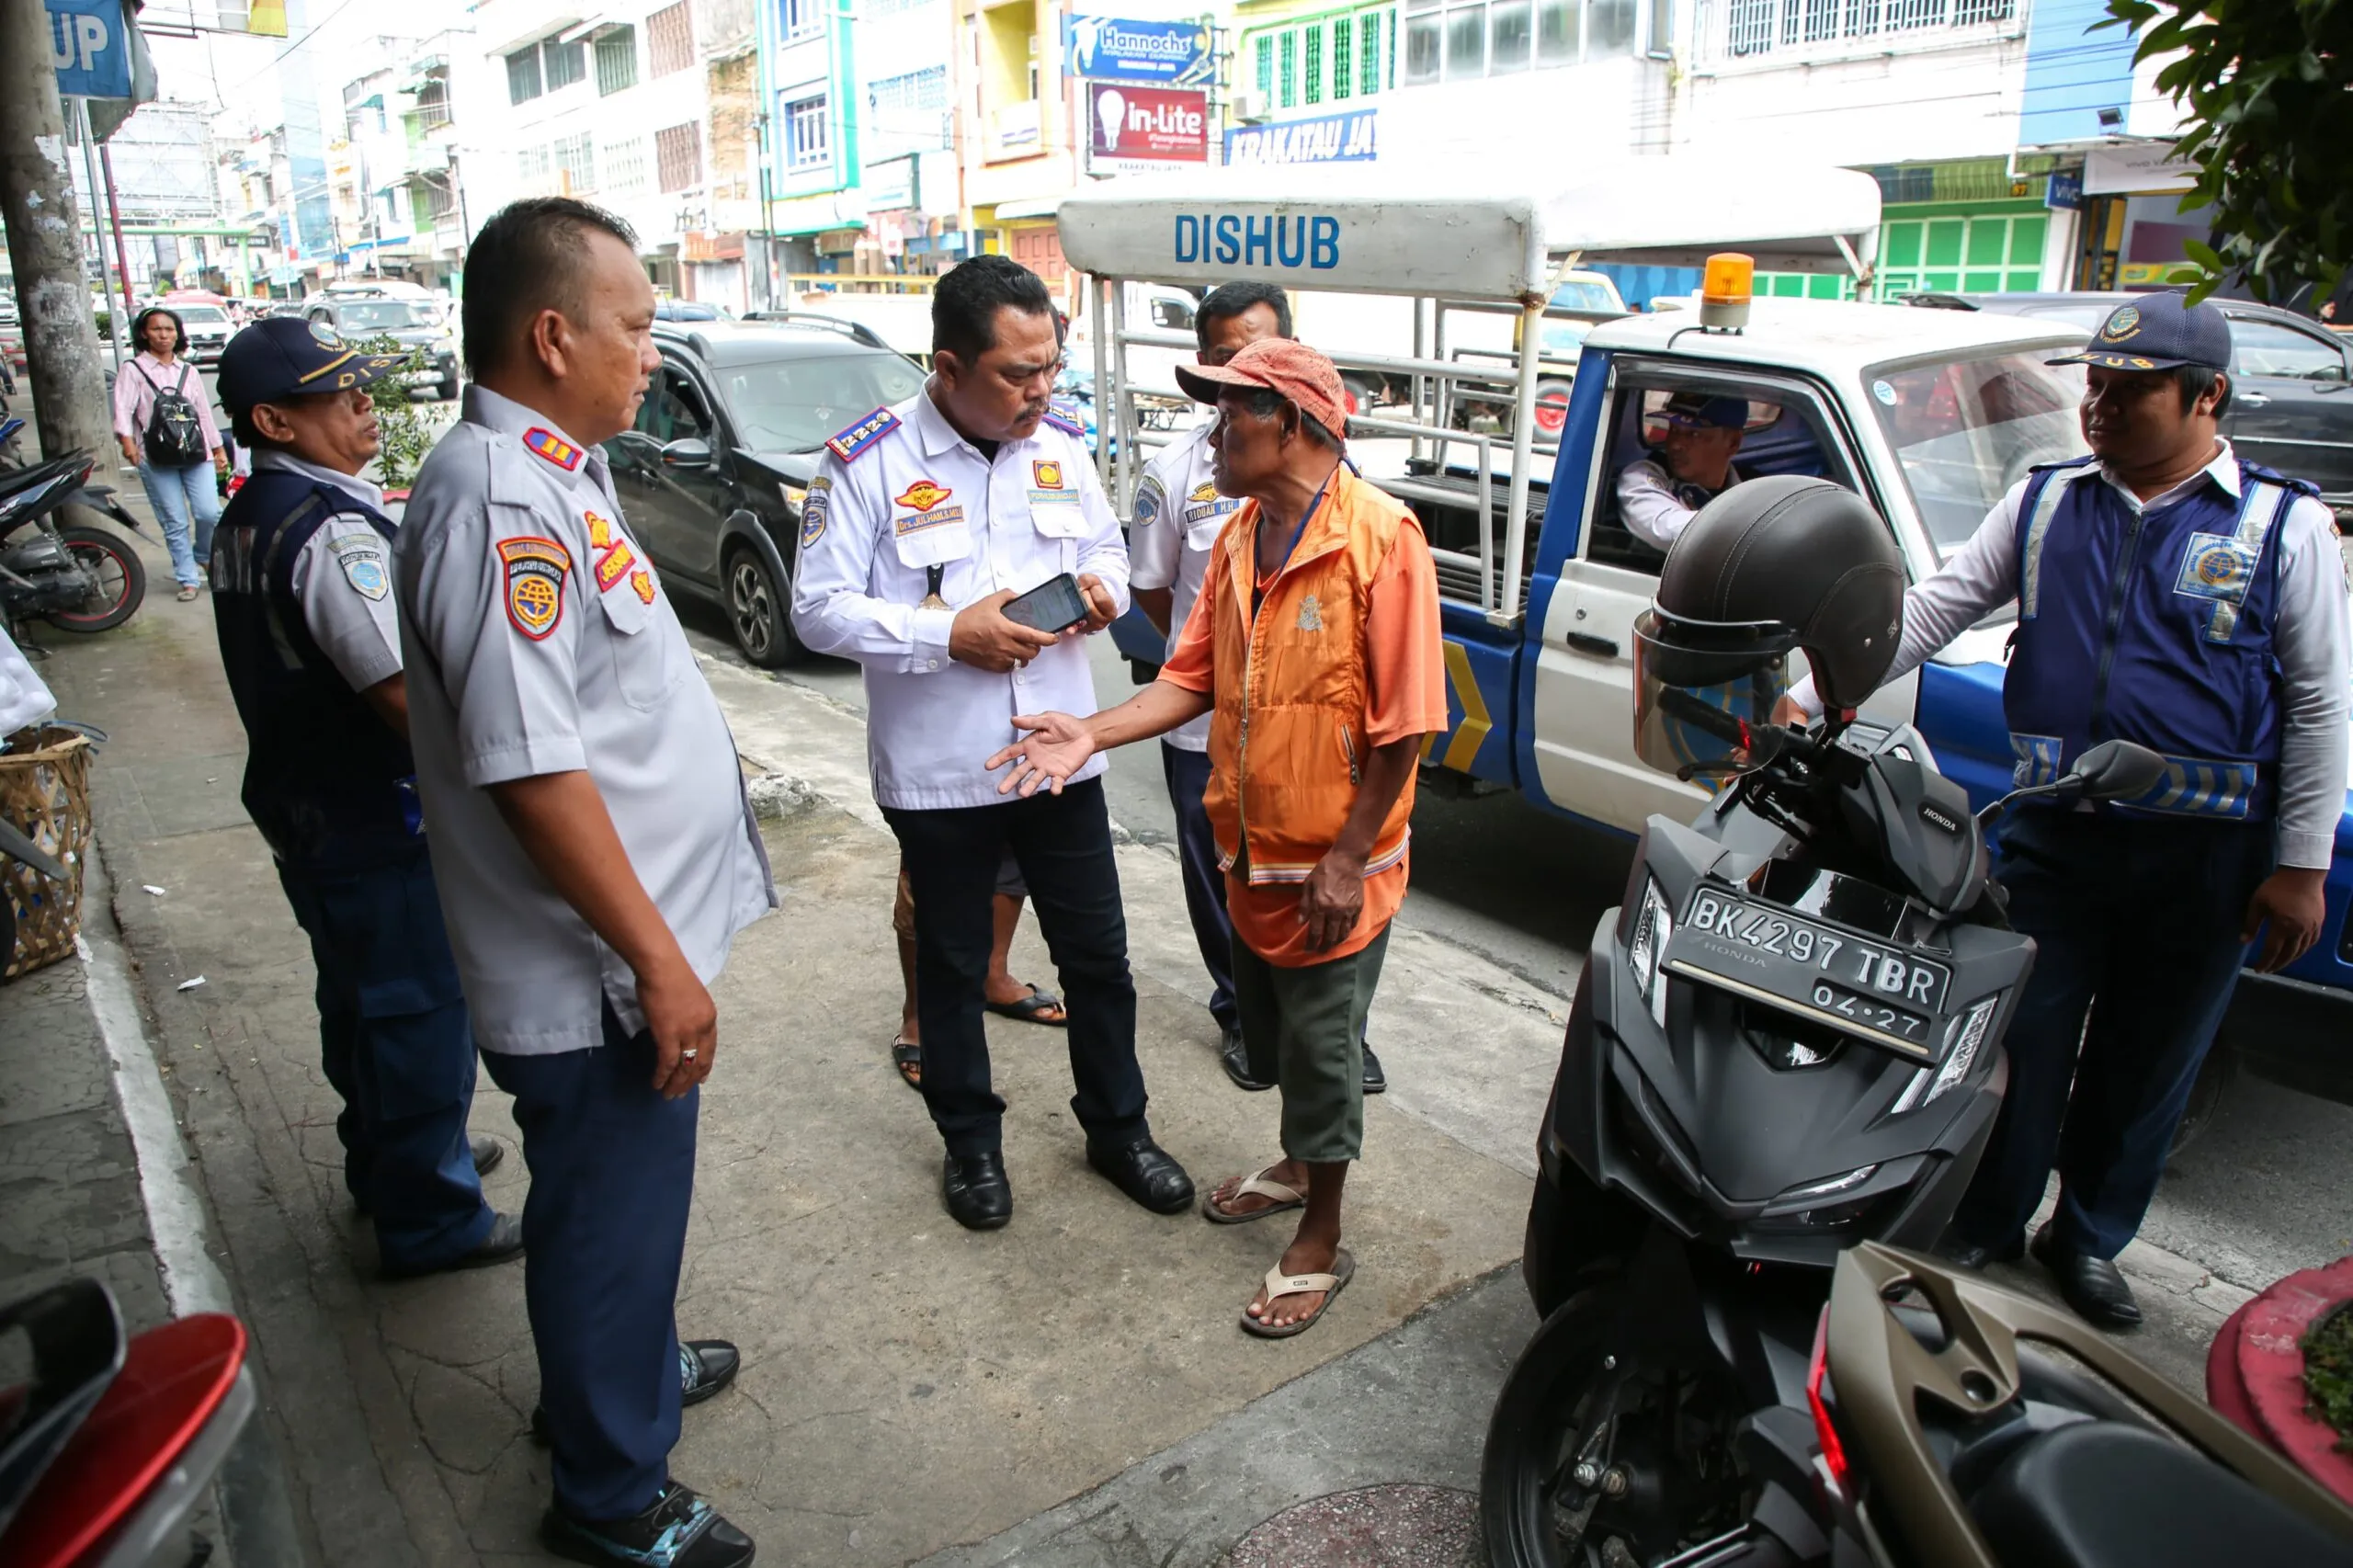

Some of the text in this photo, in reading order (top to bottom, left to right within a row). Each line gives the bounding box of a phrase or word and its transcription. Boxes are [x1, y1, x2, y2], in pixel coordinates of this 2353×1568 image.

[1102, 27, 1190, 51] Hannochs
[1229, 119, 1344, 165] KRAKATAU
[1176, 214, 1339, 269] DISHUB
[1923, 808, 1957, 832] HONDA
[1703, 942, 1768, 969] HONDA
[1857, 948, 1936, 1006] TBR
